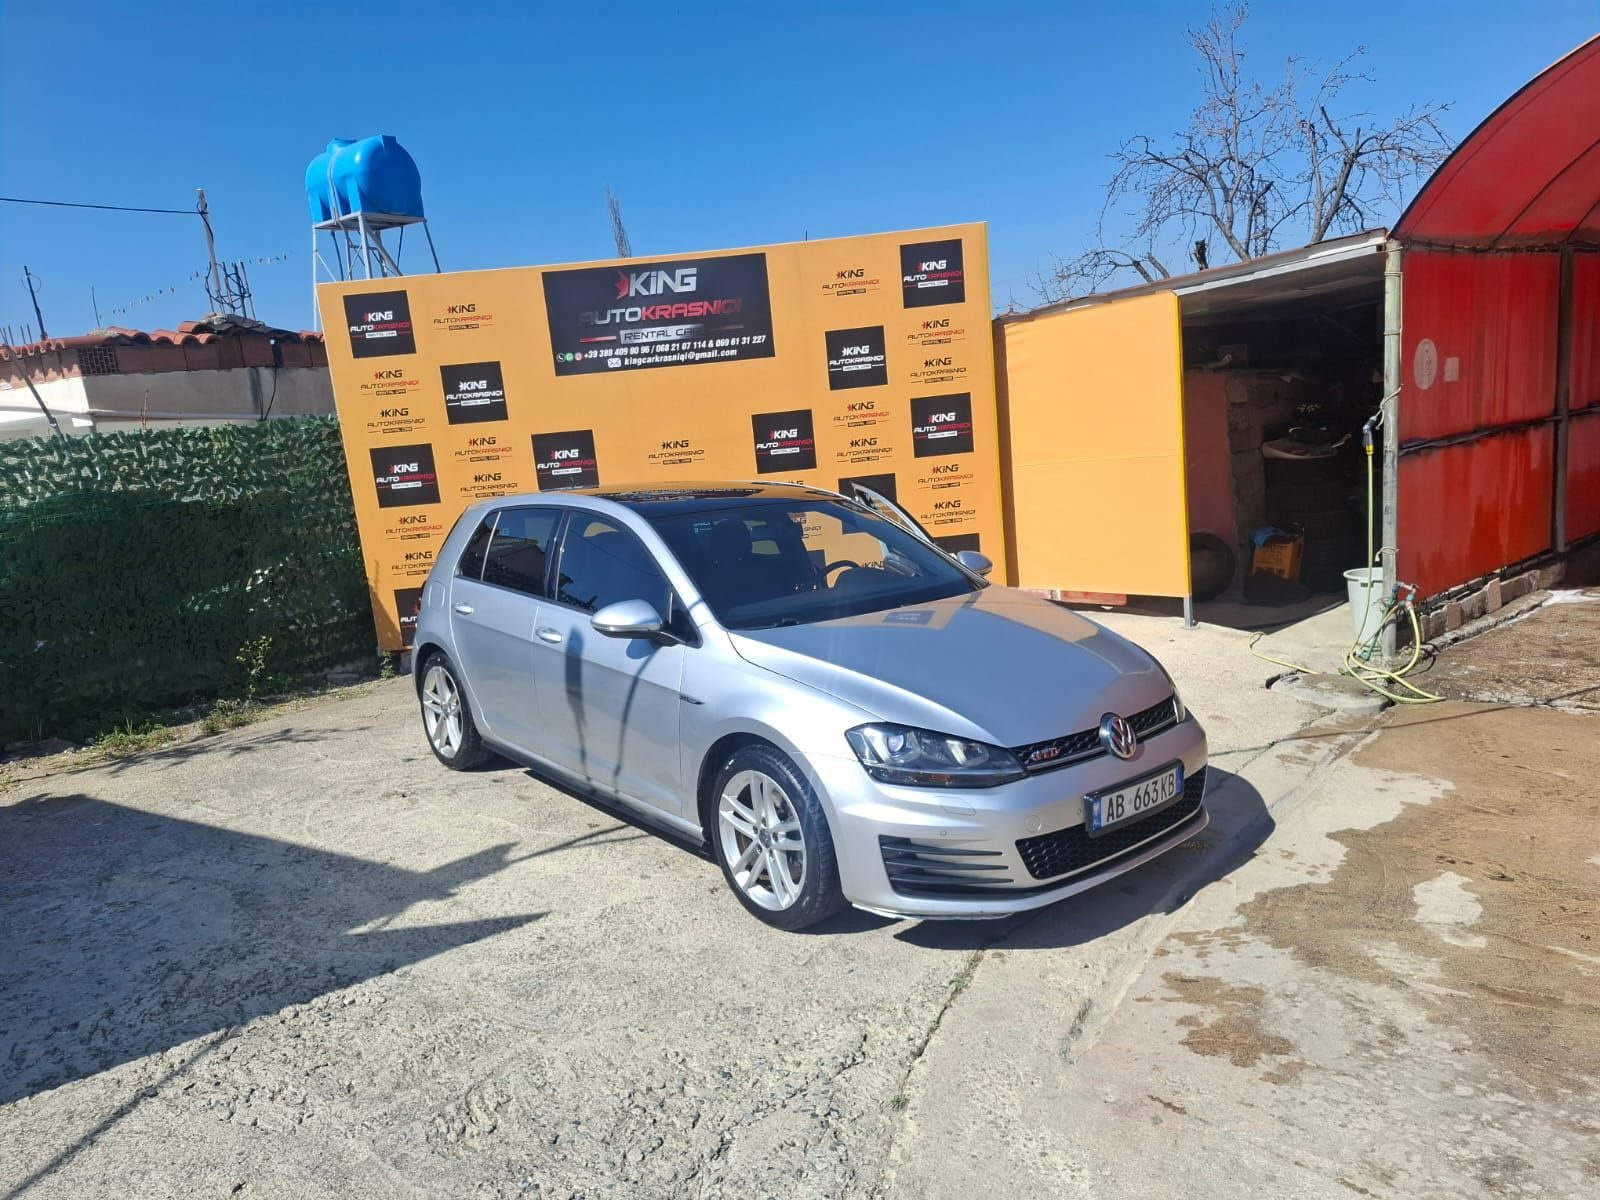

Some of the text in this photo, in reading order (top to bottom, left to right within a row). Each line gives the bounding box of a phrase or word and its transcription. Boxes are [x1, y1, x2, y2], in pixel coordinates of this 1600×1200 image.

[579, 298, 742, 325] AUTOKRASNIQI
[624, 328, 672, 341] RENTAL
[584, 350, 598, 359] +39
[614, 347, 628, 356] 409
[671, 343, 679, 351] 21
[682, 342, 691, 350] 07
[693, 341, 706, 349] 114
[708, 340, 714, 348] &
[741, 336, 750, 345] 31
[752, 335, 766, 344] 227
[624, 349, 737, 366] kingcarkrasniqi@gmail.com
[1106, 794, 1125, 823] AB
